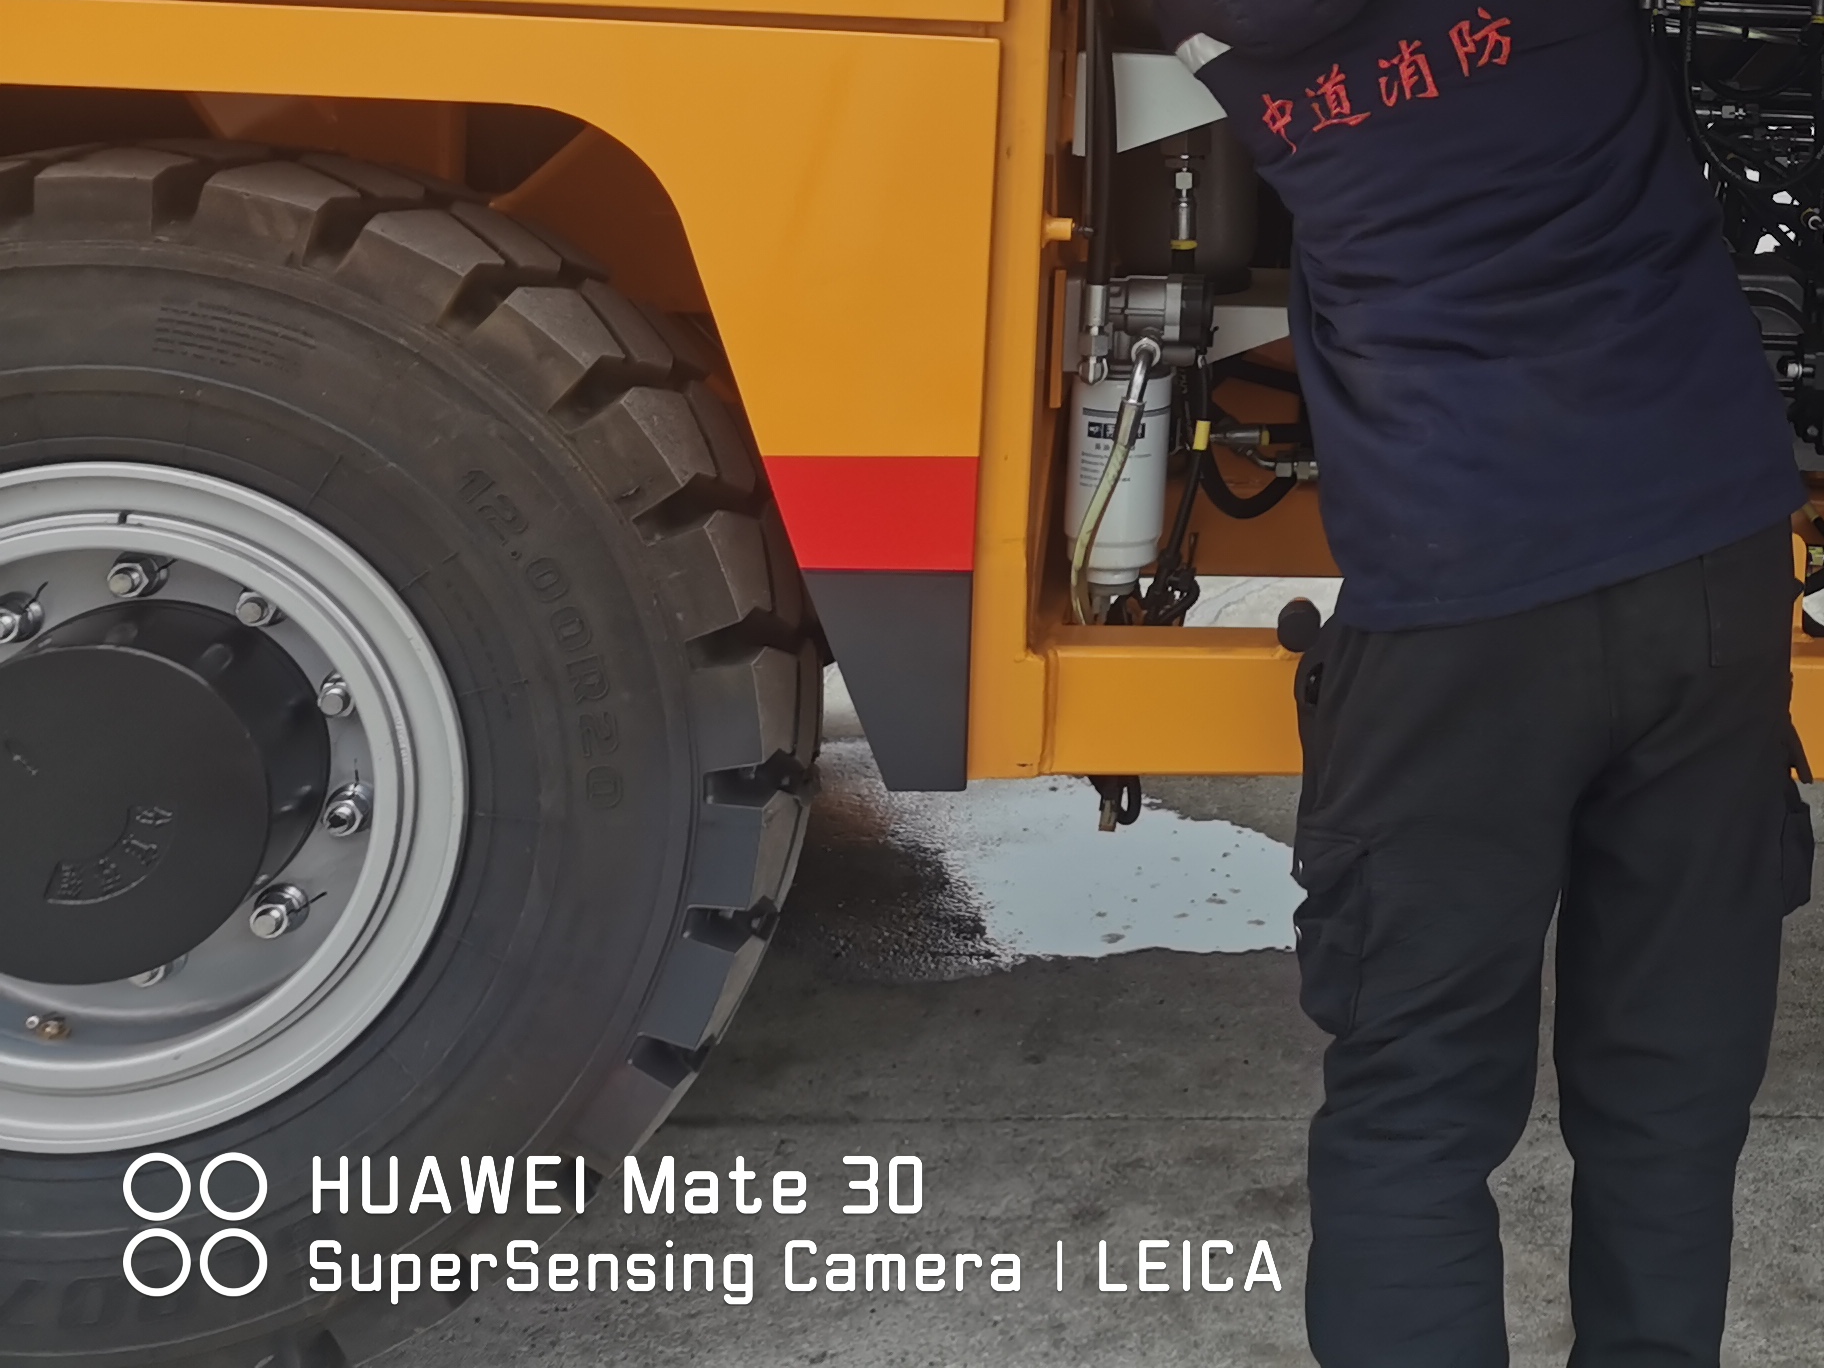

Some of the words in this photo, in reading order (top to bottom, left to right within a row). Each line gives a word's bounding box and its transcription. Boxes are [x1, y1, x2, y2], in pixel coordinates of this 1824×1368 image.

[1262, 7, 1512, 154] 中道消防
[458, 468, 624, 810] 12.00R20
